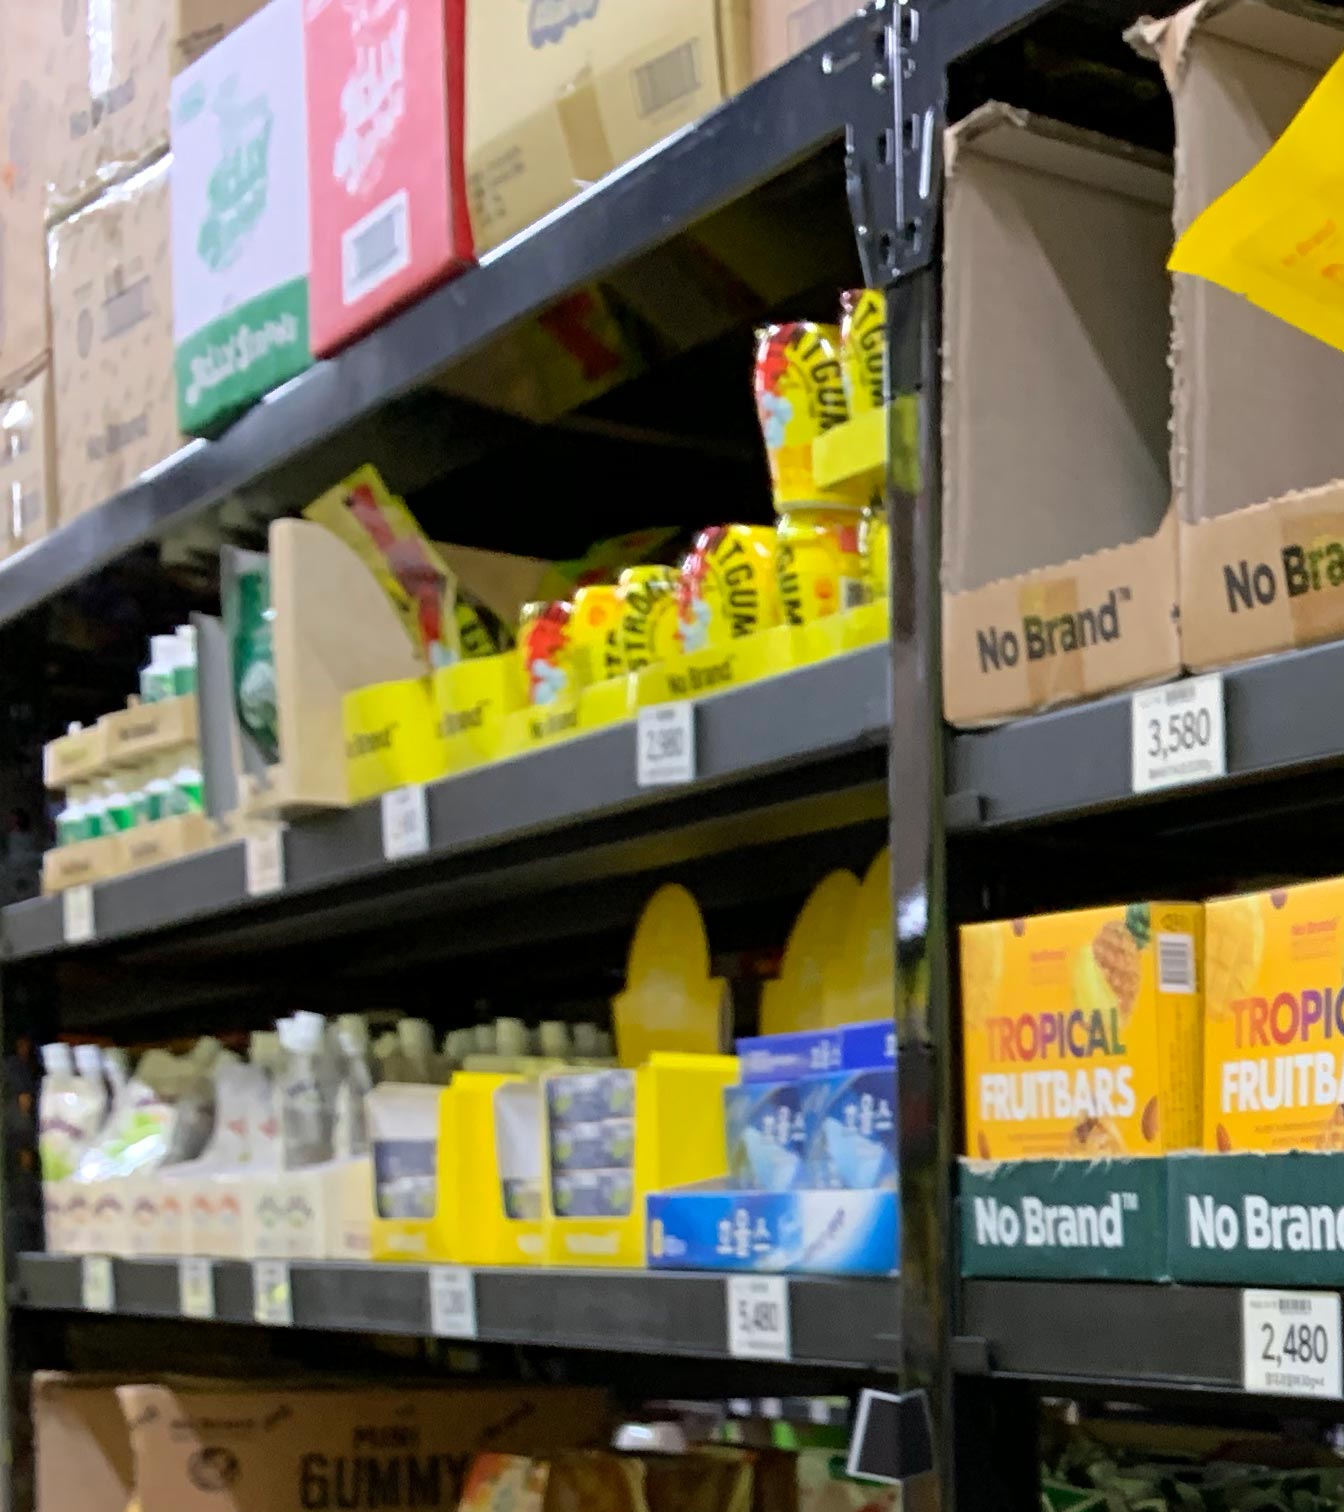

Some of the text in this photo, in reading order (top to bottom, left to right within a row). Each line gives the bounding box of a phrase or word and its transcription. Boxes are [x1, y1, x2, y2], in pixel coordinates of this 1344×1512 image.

[1223, 552, 1277, 612] No
[977, 620, 1019, 673] No
[1145, 705, 1212, 759] 3,580
[986, 1007, 1127, 1062] TROPICAL
[979, 1066, 1136, 1122] FRUITBARS
[974, 1197, 1018, 1248] No
[1187, 1195, 1239, 1250] No
[1260, 1323, 1330, 1367] 2,480
